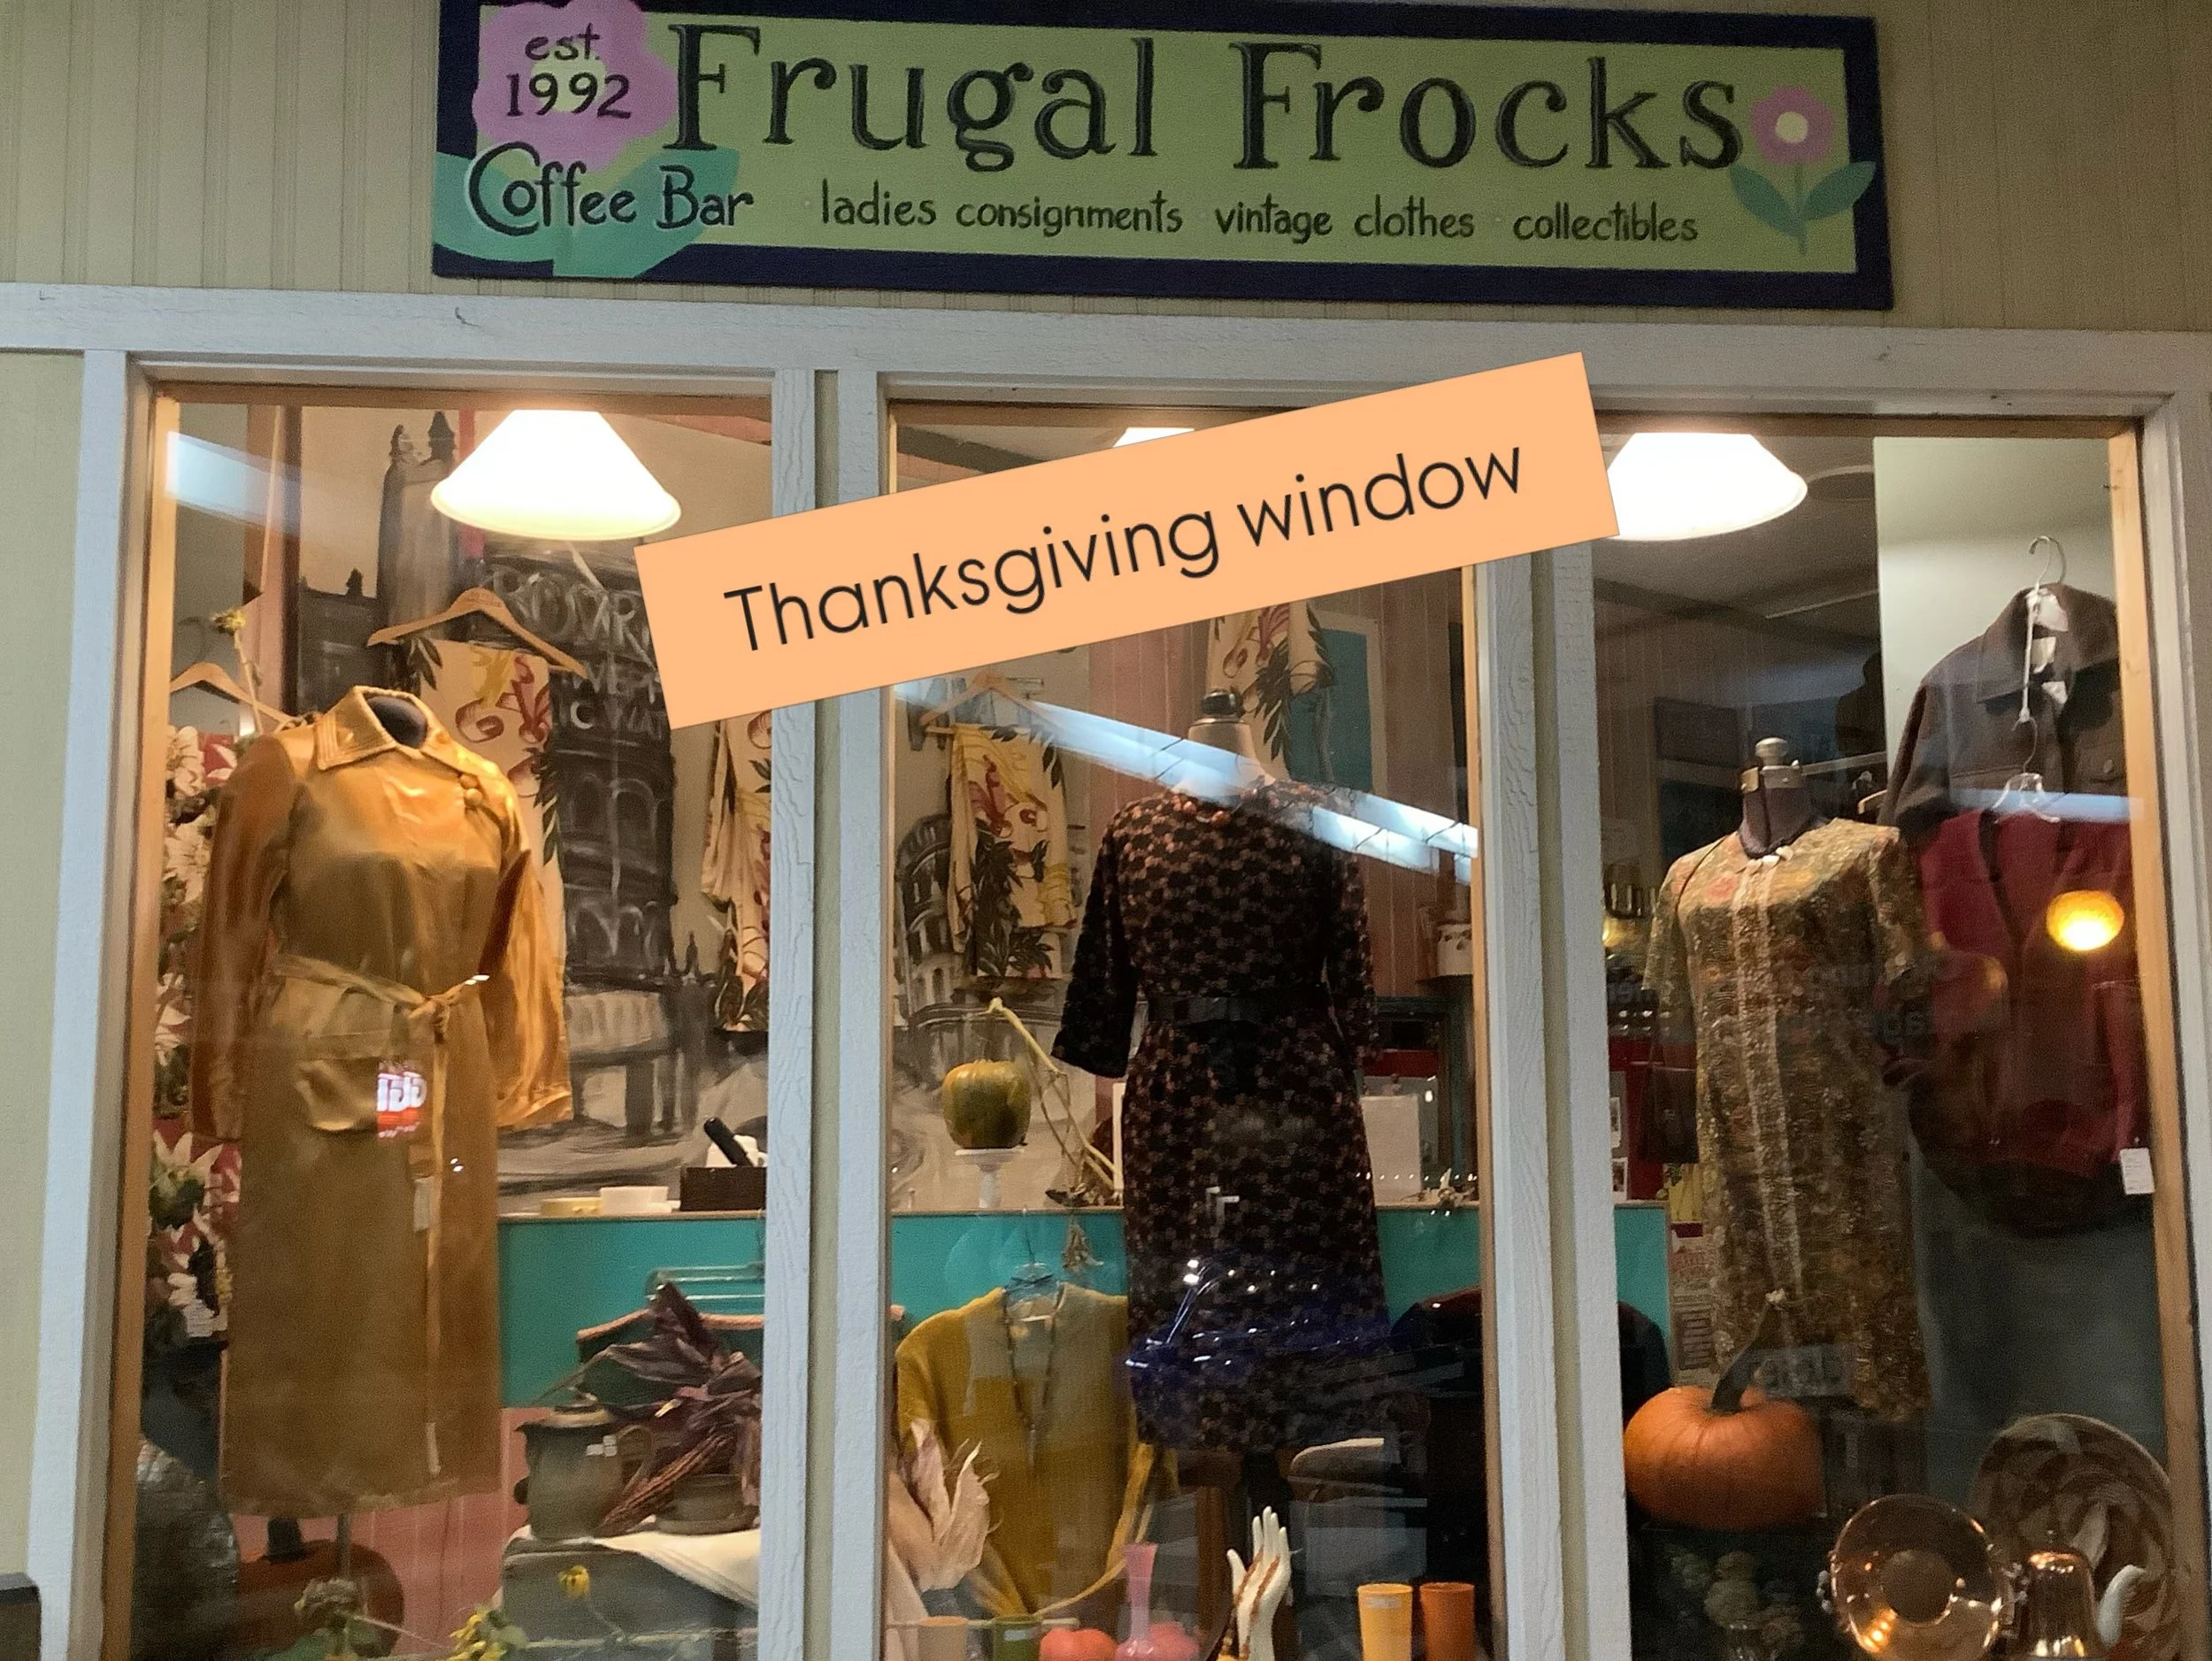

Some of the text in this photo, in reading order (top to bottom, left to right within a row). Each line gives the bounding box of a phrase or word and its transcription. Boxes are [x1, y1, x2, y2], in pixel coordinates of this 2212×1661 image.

[505, 73, 632, 119] 1992
[662, 23, 1743, 172] Frugal Frocks
[468, 141, 755, 237] Coffee Bar
[821, 178, 1699, 244] ladies consignments vintage clothes collectibles
